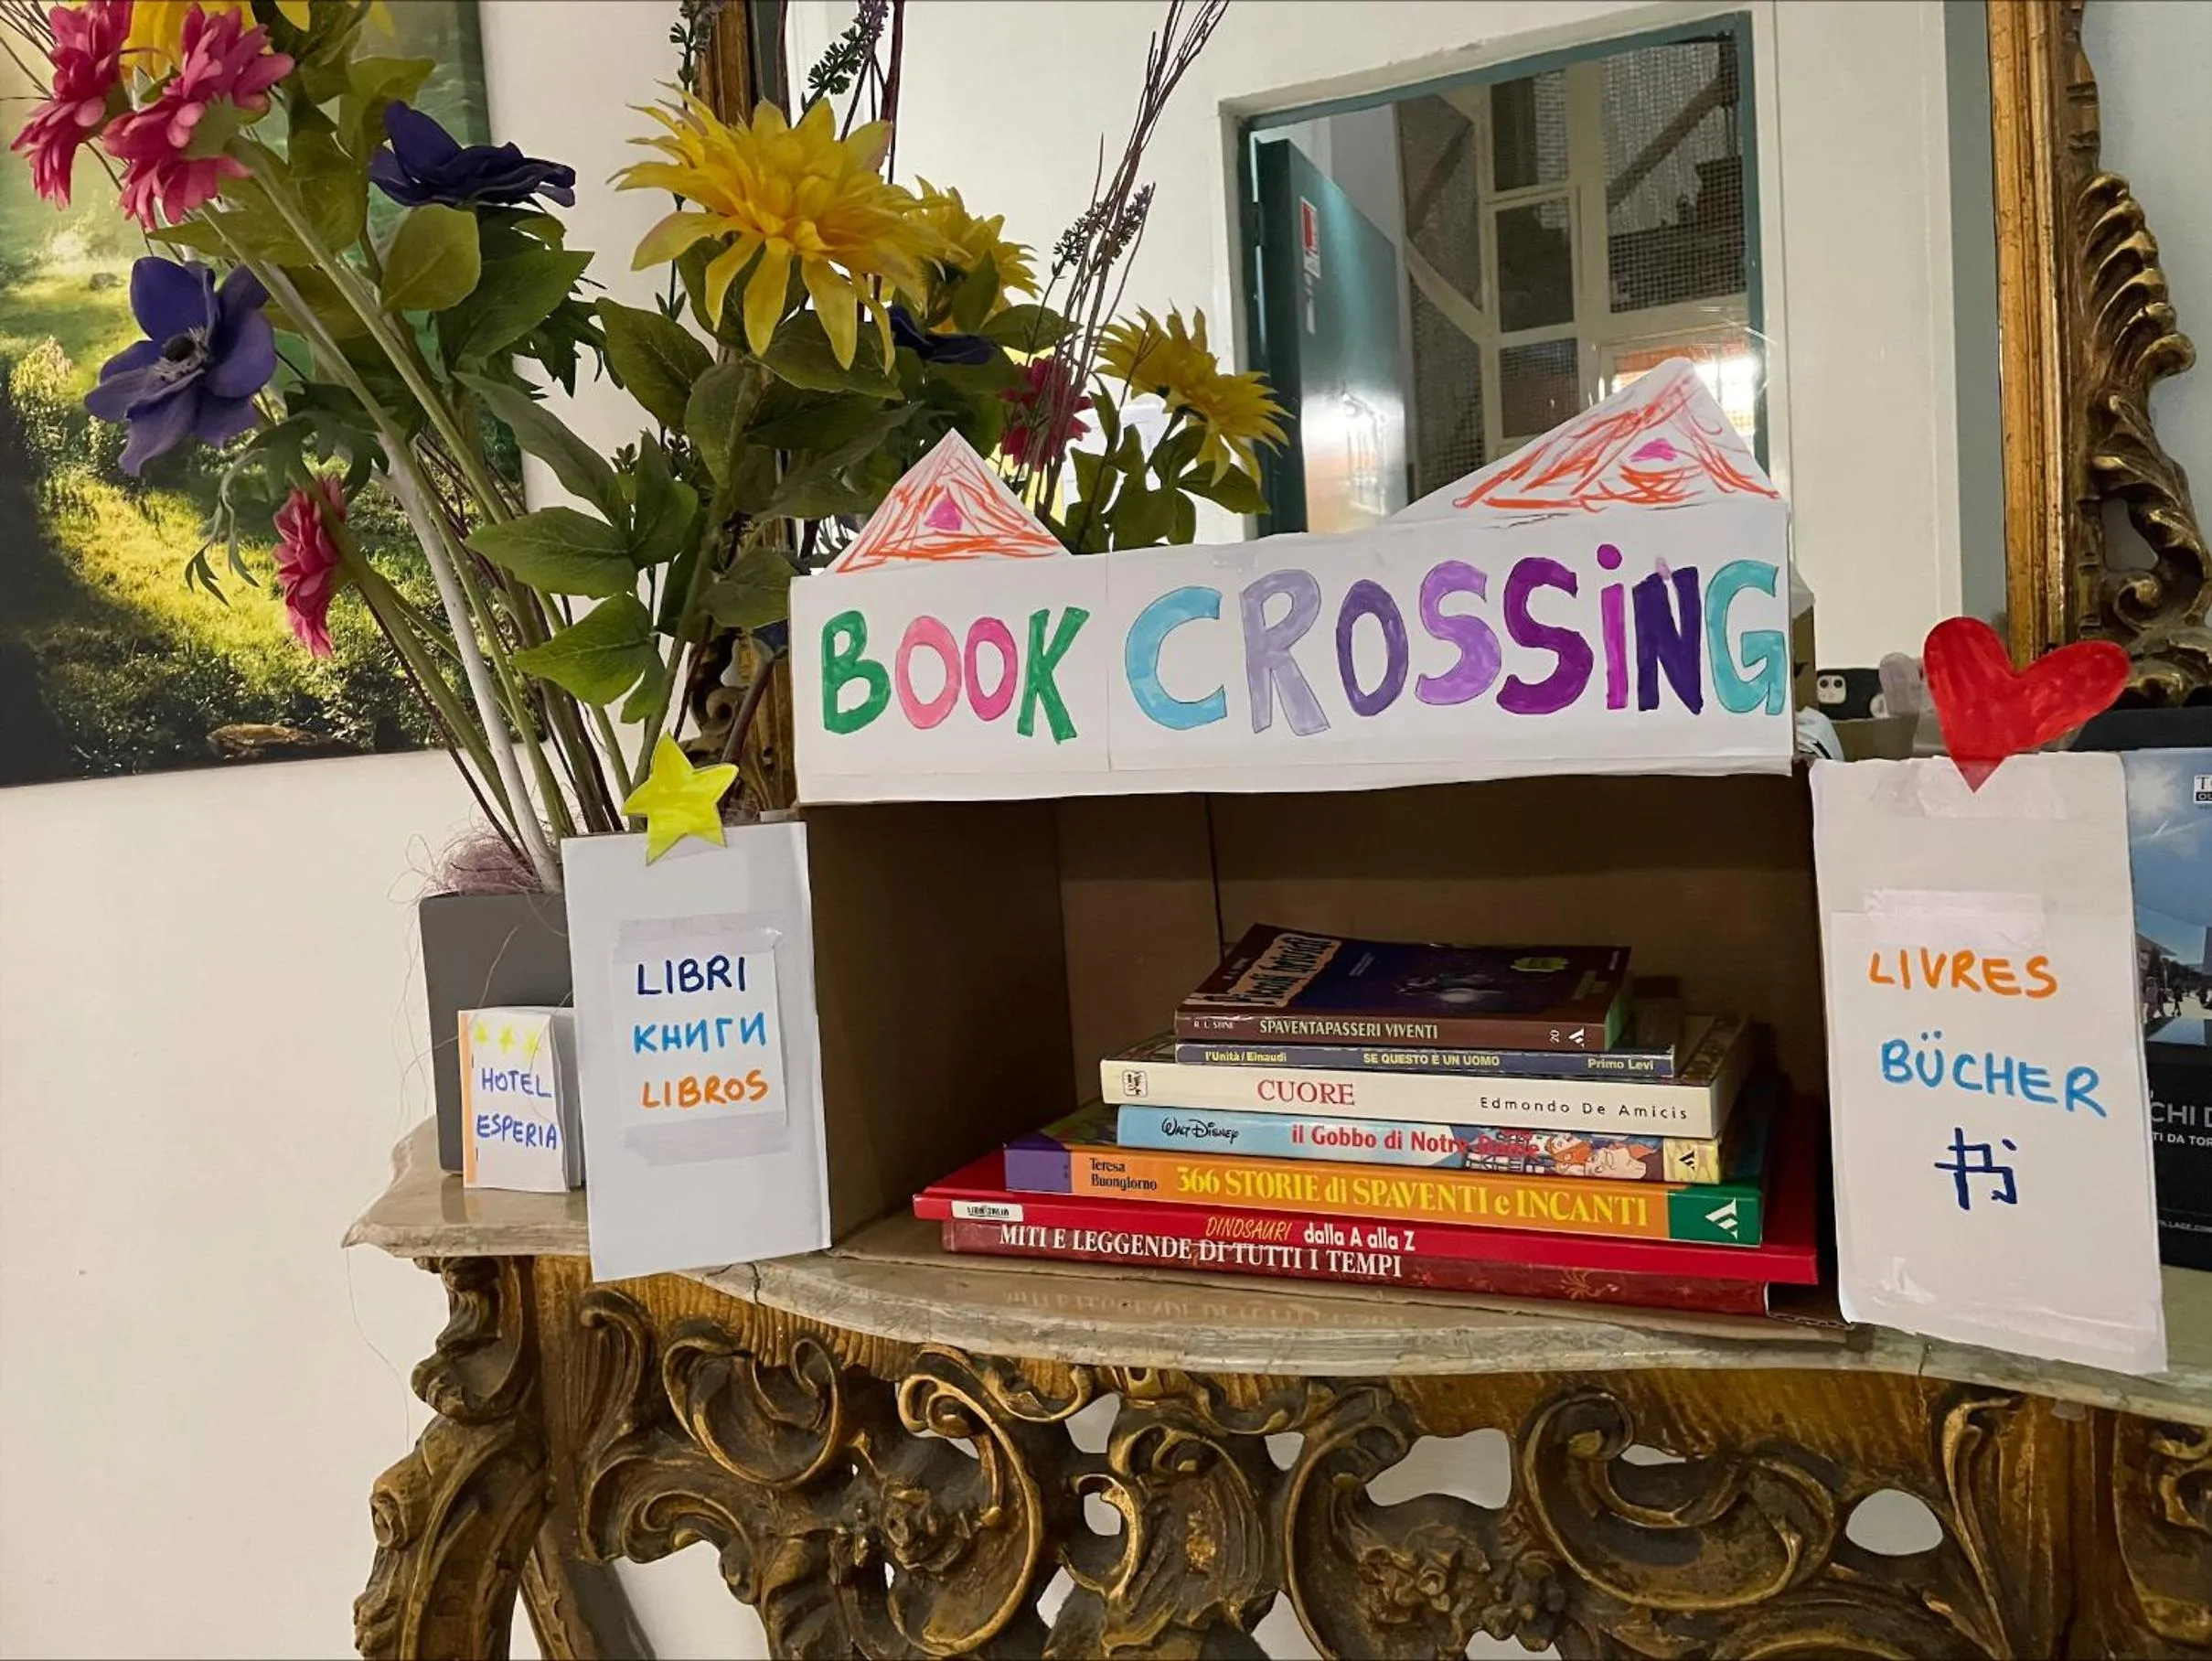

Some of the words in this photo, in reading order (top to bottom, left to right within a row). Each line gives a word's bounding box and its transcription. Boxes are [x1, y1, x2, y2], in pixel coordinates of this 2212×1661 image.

[822, 606, 1090, 744] BOOK
[636, 955, 745, 995] LIBRI
[1869, 948, 2058, 998] LIVRES
[633, 1012, 766, 1054] КНИГИ
[1259, 1019, 1381, 1037] SPAVENTAPASSERI
[1385, 1023, 1438, 1040] VIVENTI
[1363, 1053, 1379, 1063] SE
[1382, 1054, 1428, 1065] QUESTO
[1443, 1055, 1459, 1066] UN
[1463, 1056, 1501, 1066] UOMO
[1587, 1058, 1624, 1069] Primo
[1628, 1059, 1653, 1070] Levi
[1881, 1031, 2107, 1118] BÜCHER
[482, 1067, 552, 1098] HOTEL
[642, 1069, 768, 1109] LIBROS
[1257, 1079, 1355, 1105] CUORE
[1480, 1097, 1570, 1113] Edmondo
[1582, 1102, 1606, 1115] De
[1619, 1104, 1687, 1120] Amicis
[2151, 1101, 2196, 1126] CHI
[476, 1115, 558, 1150] ESPERIA
[1292, 1124, 1303, 1144] il
[1311, 1125, 1376, 1149] Gobbo
[1384, 1128, 1403, 1150] di
[2153, 1132, 2163, 1141] TI
[2167, 1133, 2185, 1143] DA
[2187, 1135, 2212, 1147] TOR
[1090, 1158, 1126, 1173] Teresa
[1091, 1173, 1157, 1191] Buongiorno
[1177, 1166, 1219, 1194] 366
[1224, 1170, 1320, 1201] STORIE
[1326, 1177, 1347, 1204] di
[1352, 1180, 1488, 1215] SPAVENTI
[1494, 1195, 1511, 1216] e
[1516, 1191, 1647, 1227] INCANTI
[1206, 1216, 1292, 1241] DINOSAURI
[1303, 1222, 1345, 1247] dalla
[1351, 1227, 1362, 1247] A
[1367, 1227, 1398, 1250] alla
[1404, 1230, 1416, 1251] Z
[999, 1224, 1047, 1247] MITI
[1053, 1228, 1065, 1249] E
[1073, 1229, 1192, 1259] LEGGENDE
[1199, 1239, 1225, 1263] DI
[1232, 1242, 1302, 1270] TUTTI
[1309, 1249, 1319, 1270] I
[1326, 1249, 1402, 1278] TEMPI
